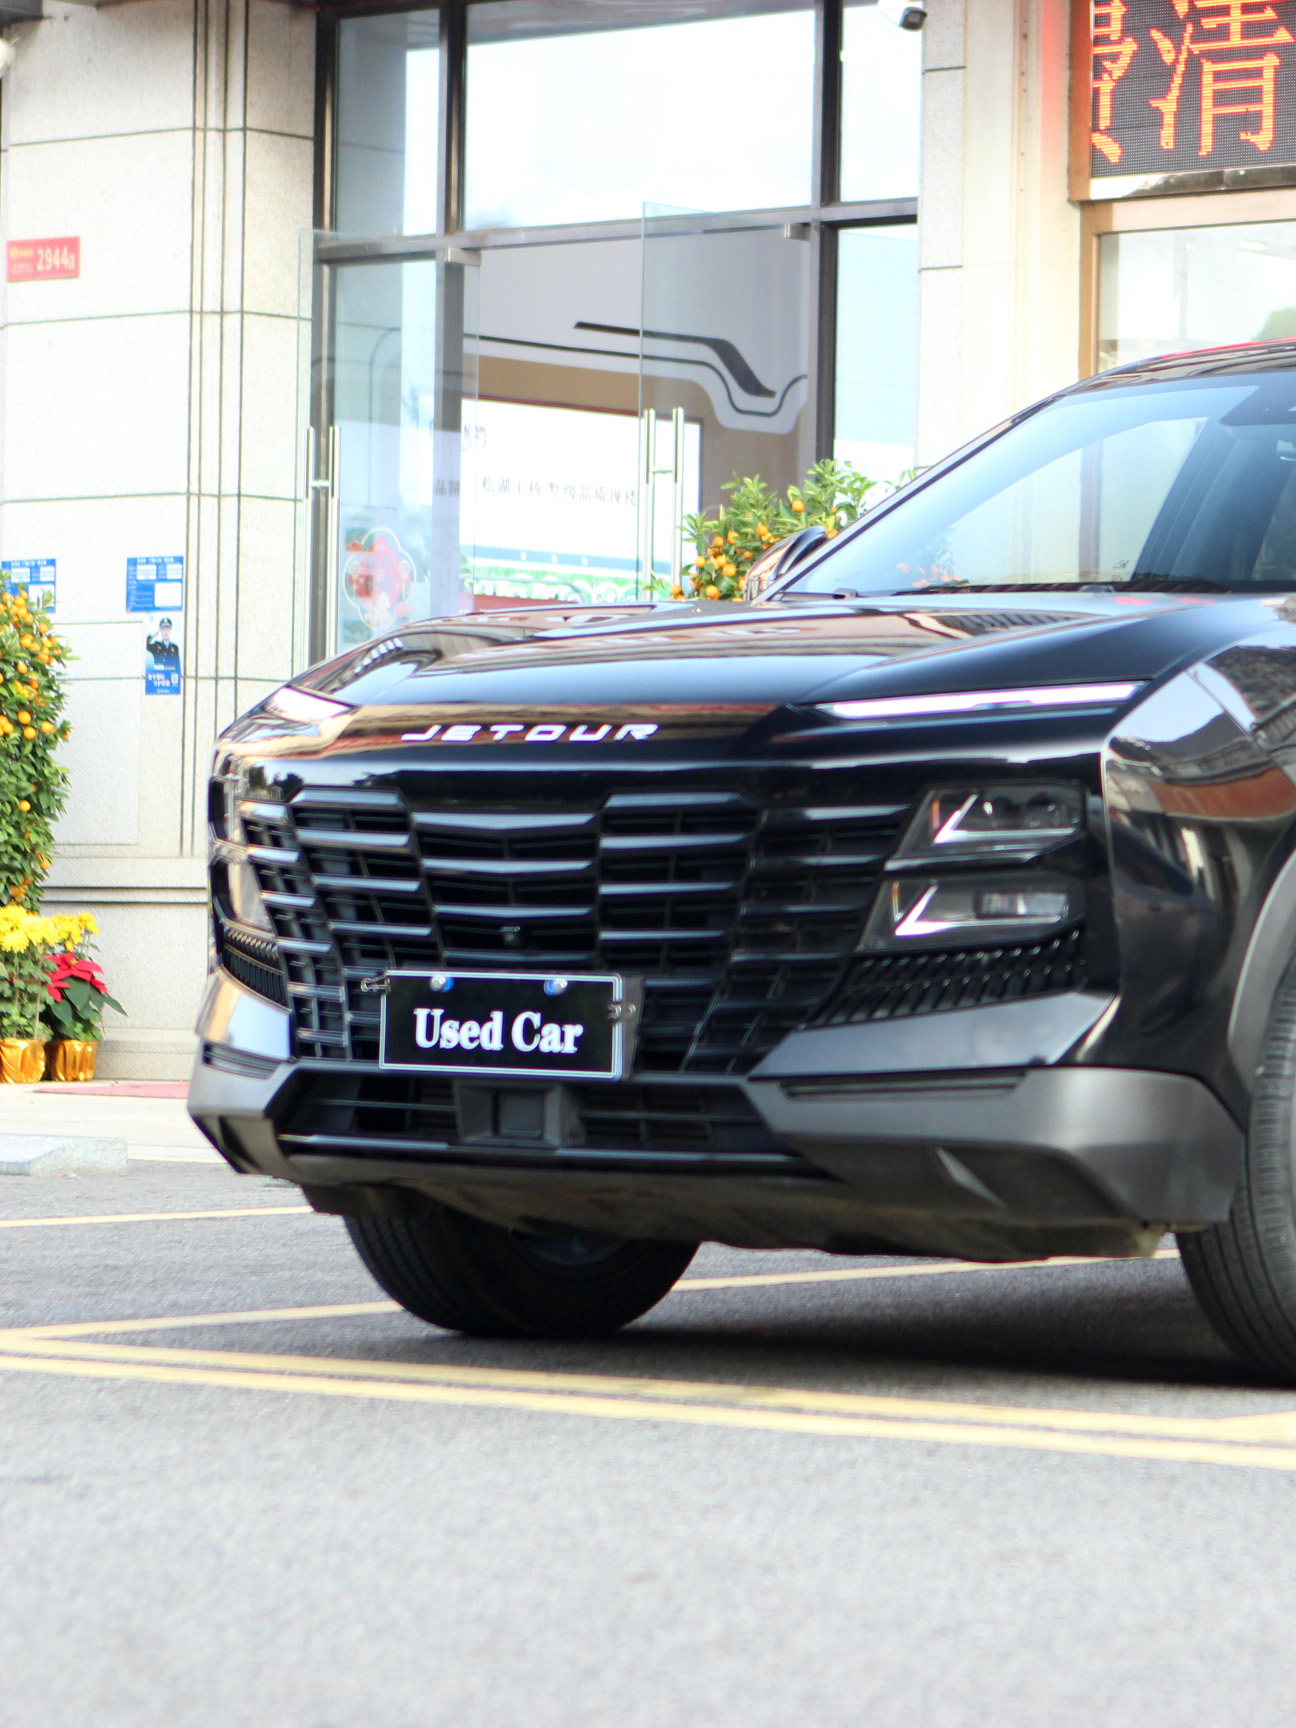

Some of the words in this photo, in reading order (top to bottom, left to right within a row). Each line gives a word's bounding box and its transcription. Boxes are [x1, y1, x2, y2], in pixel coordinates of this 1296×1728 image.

[401, 723, 659, 743] JETOUR
[413, 1007, 504, 1050] Used
[511, 1011, 584, 1054] Car
